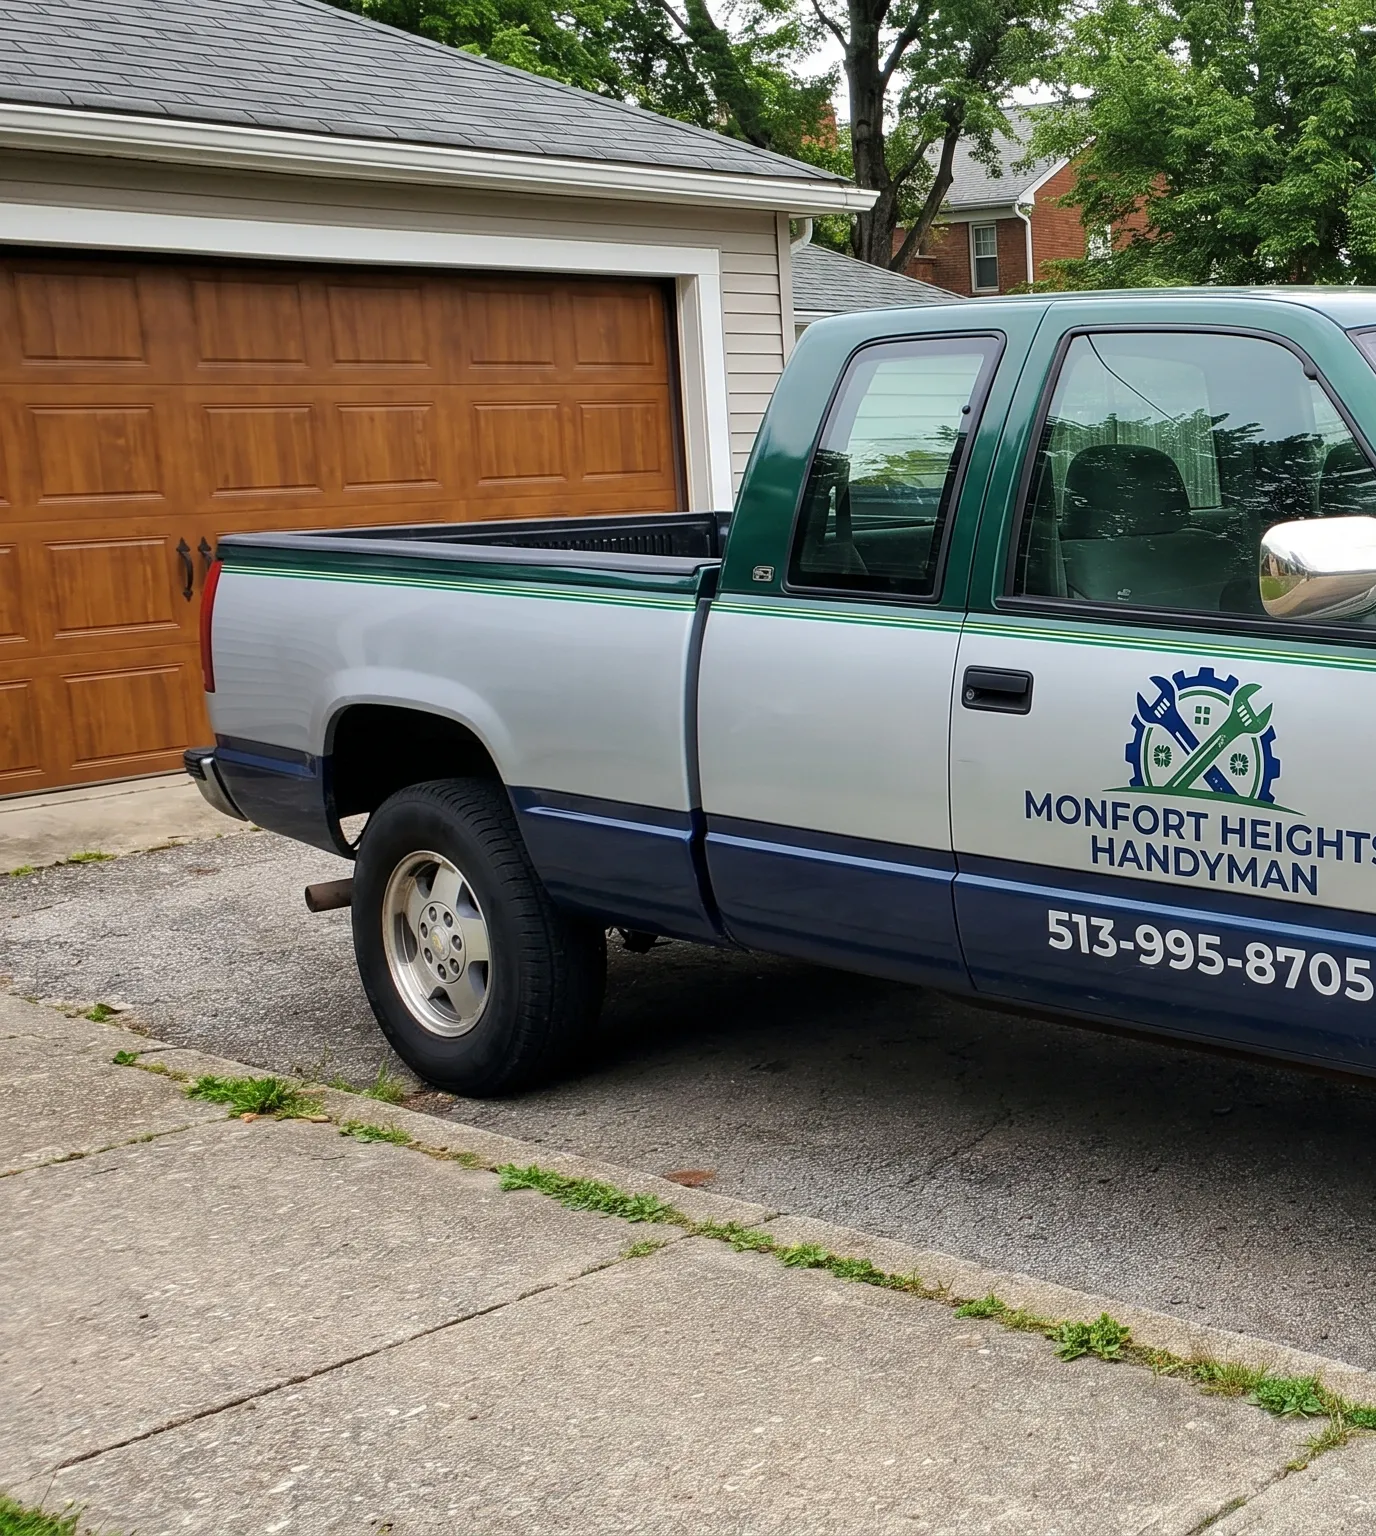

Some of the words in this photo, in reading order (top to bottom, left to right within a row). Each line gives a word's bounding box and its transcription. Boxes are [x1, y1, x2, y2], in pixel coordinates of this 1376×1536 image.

[1025, 790, 1208, 841] MONFORT
[1091, 835, 1318, 896] HANDYMAN
[1048, 909, 1375, 1001] 513-995-8705
